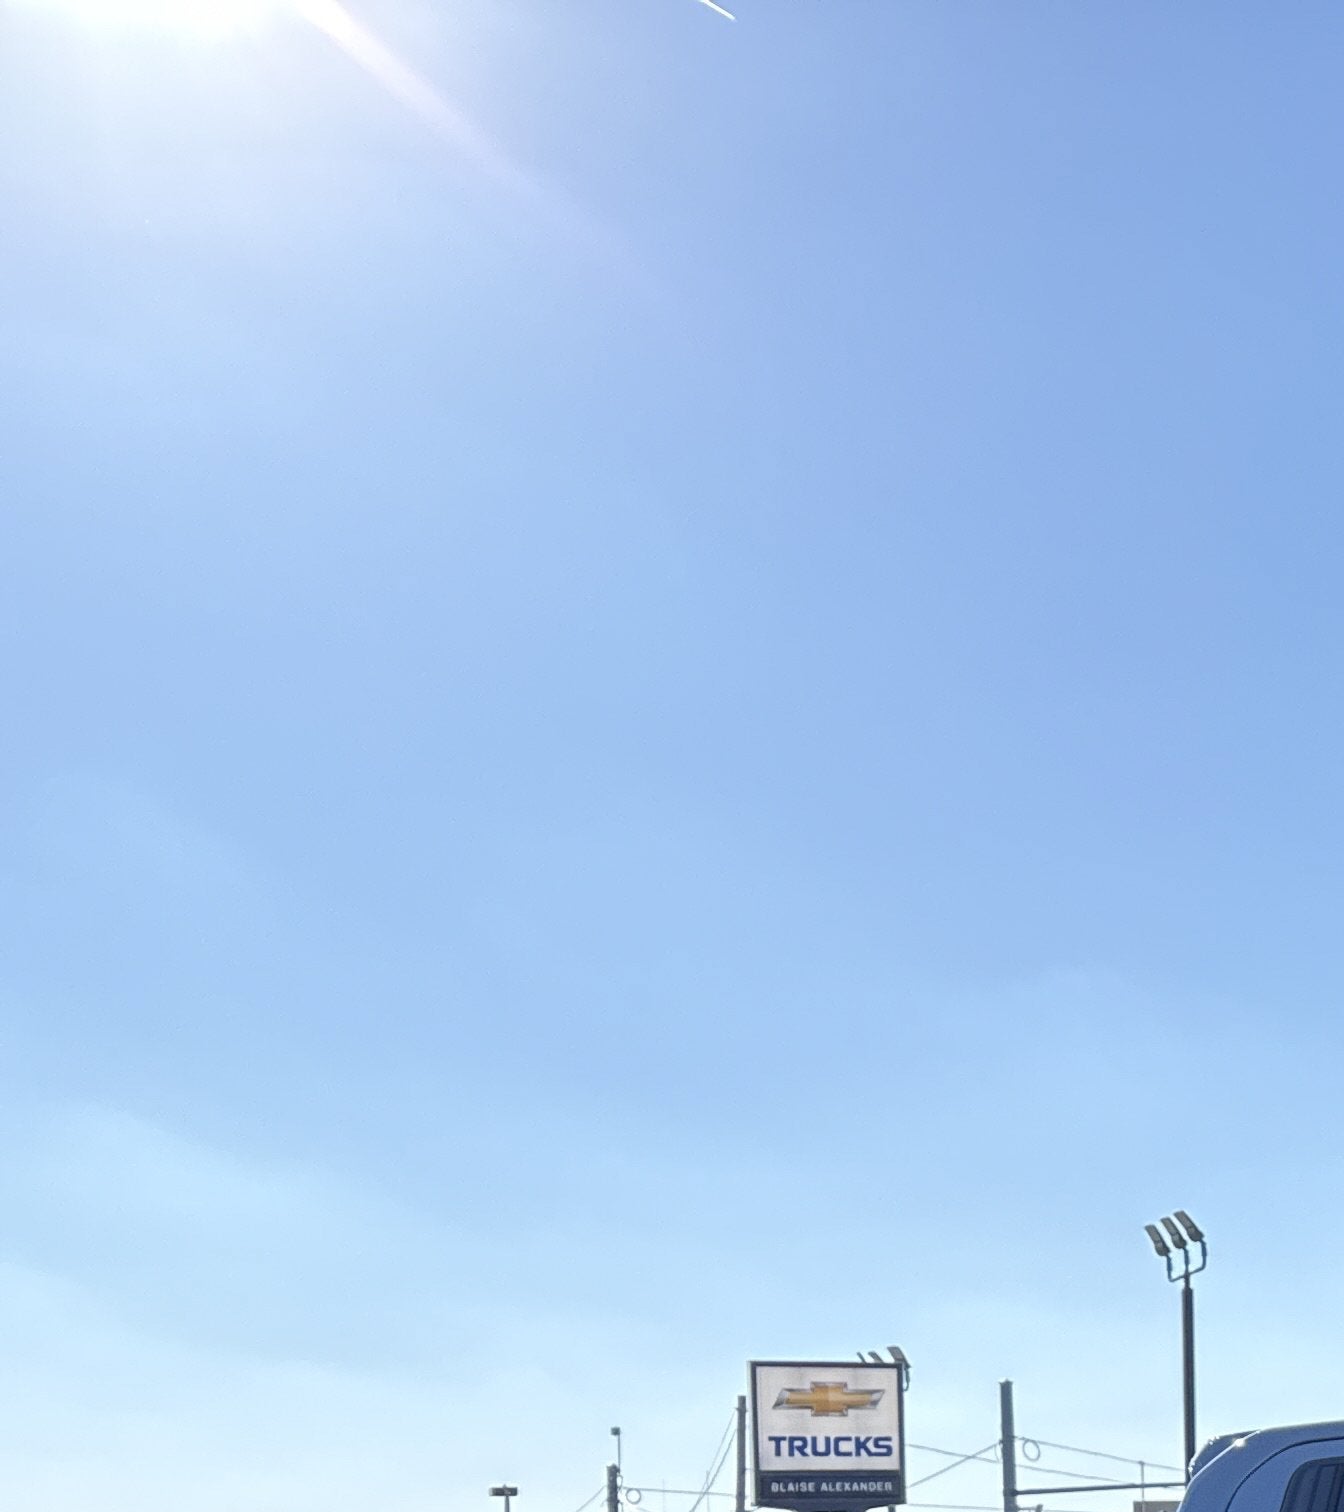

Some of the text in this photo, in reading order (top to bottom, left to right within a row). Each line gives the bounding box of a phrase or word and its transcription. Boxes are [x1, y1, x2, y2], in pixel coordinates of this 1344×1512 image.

[768, 1435, 893, 1457] TRUCKS
[771, 1481, 893, 1493] BLAISE ALEXANDER
